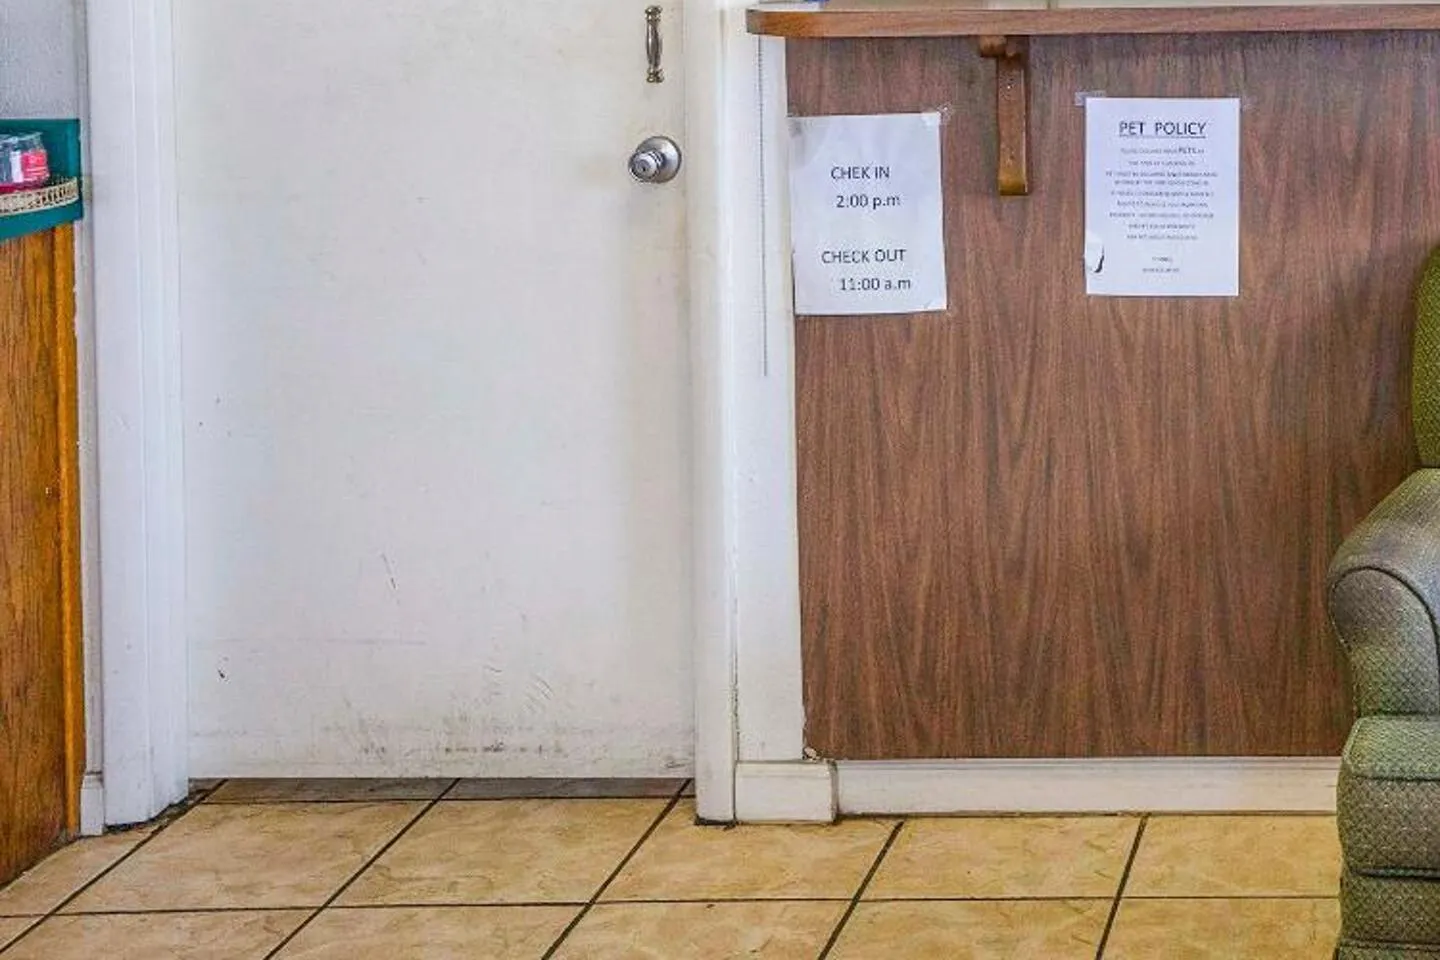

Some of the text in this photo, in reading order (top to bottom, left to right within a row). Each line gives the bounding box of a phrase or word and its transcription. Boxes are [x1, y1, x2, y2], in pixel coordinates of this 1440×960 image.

[1119, 121, 1207, 136] PET POLICY
[830, 166, 891, 180] CHEK IN
[836, 195, 901, 210] 2:00 p.m
[821, 248, 907, 264] CHECK OUT
[840, 278, 911, 291] 11:00 a.m
